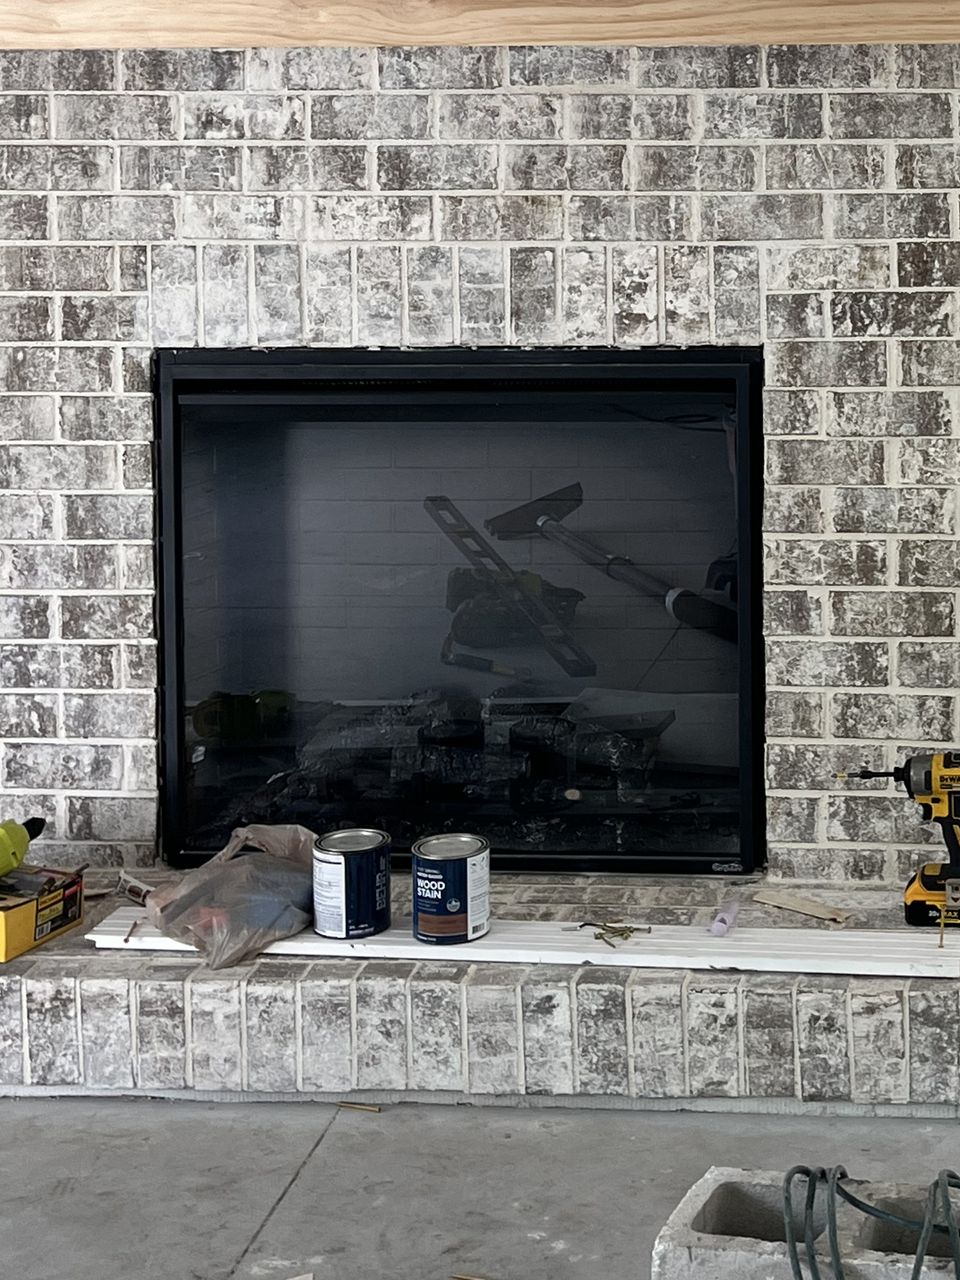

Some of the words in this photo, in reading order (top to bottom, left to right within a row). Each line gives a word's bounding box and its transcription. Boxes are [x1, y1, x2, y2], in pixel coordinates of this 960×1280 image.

[417, 878, 446, 891] WOOD
[375, 872, 387, 911] BEHR
[417, 887, 442, 899] STAIN
